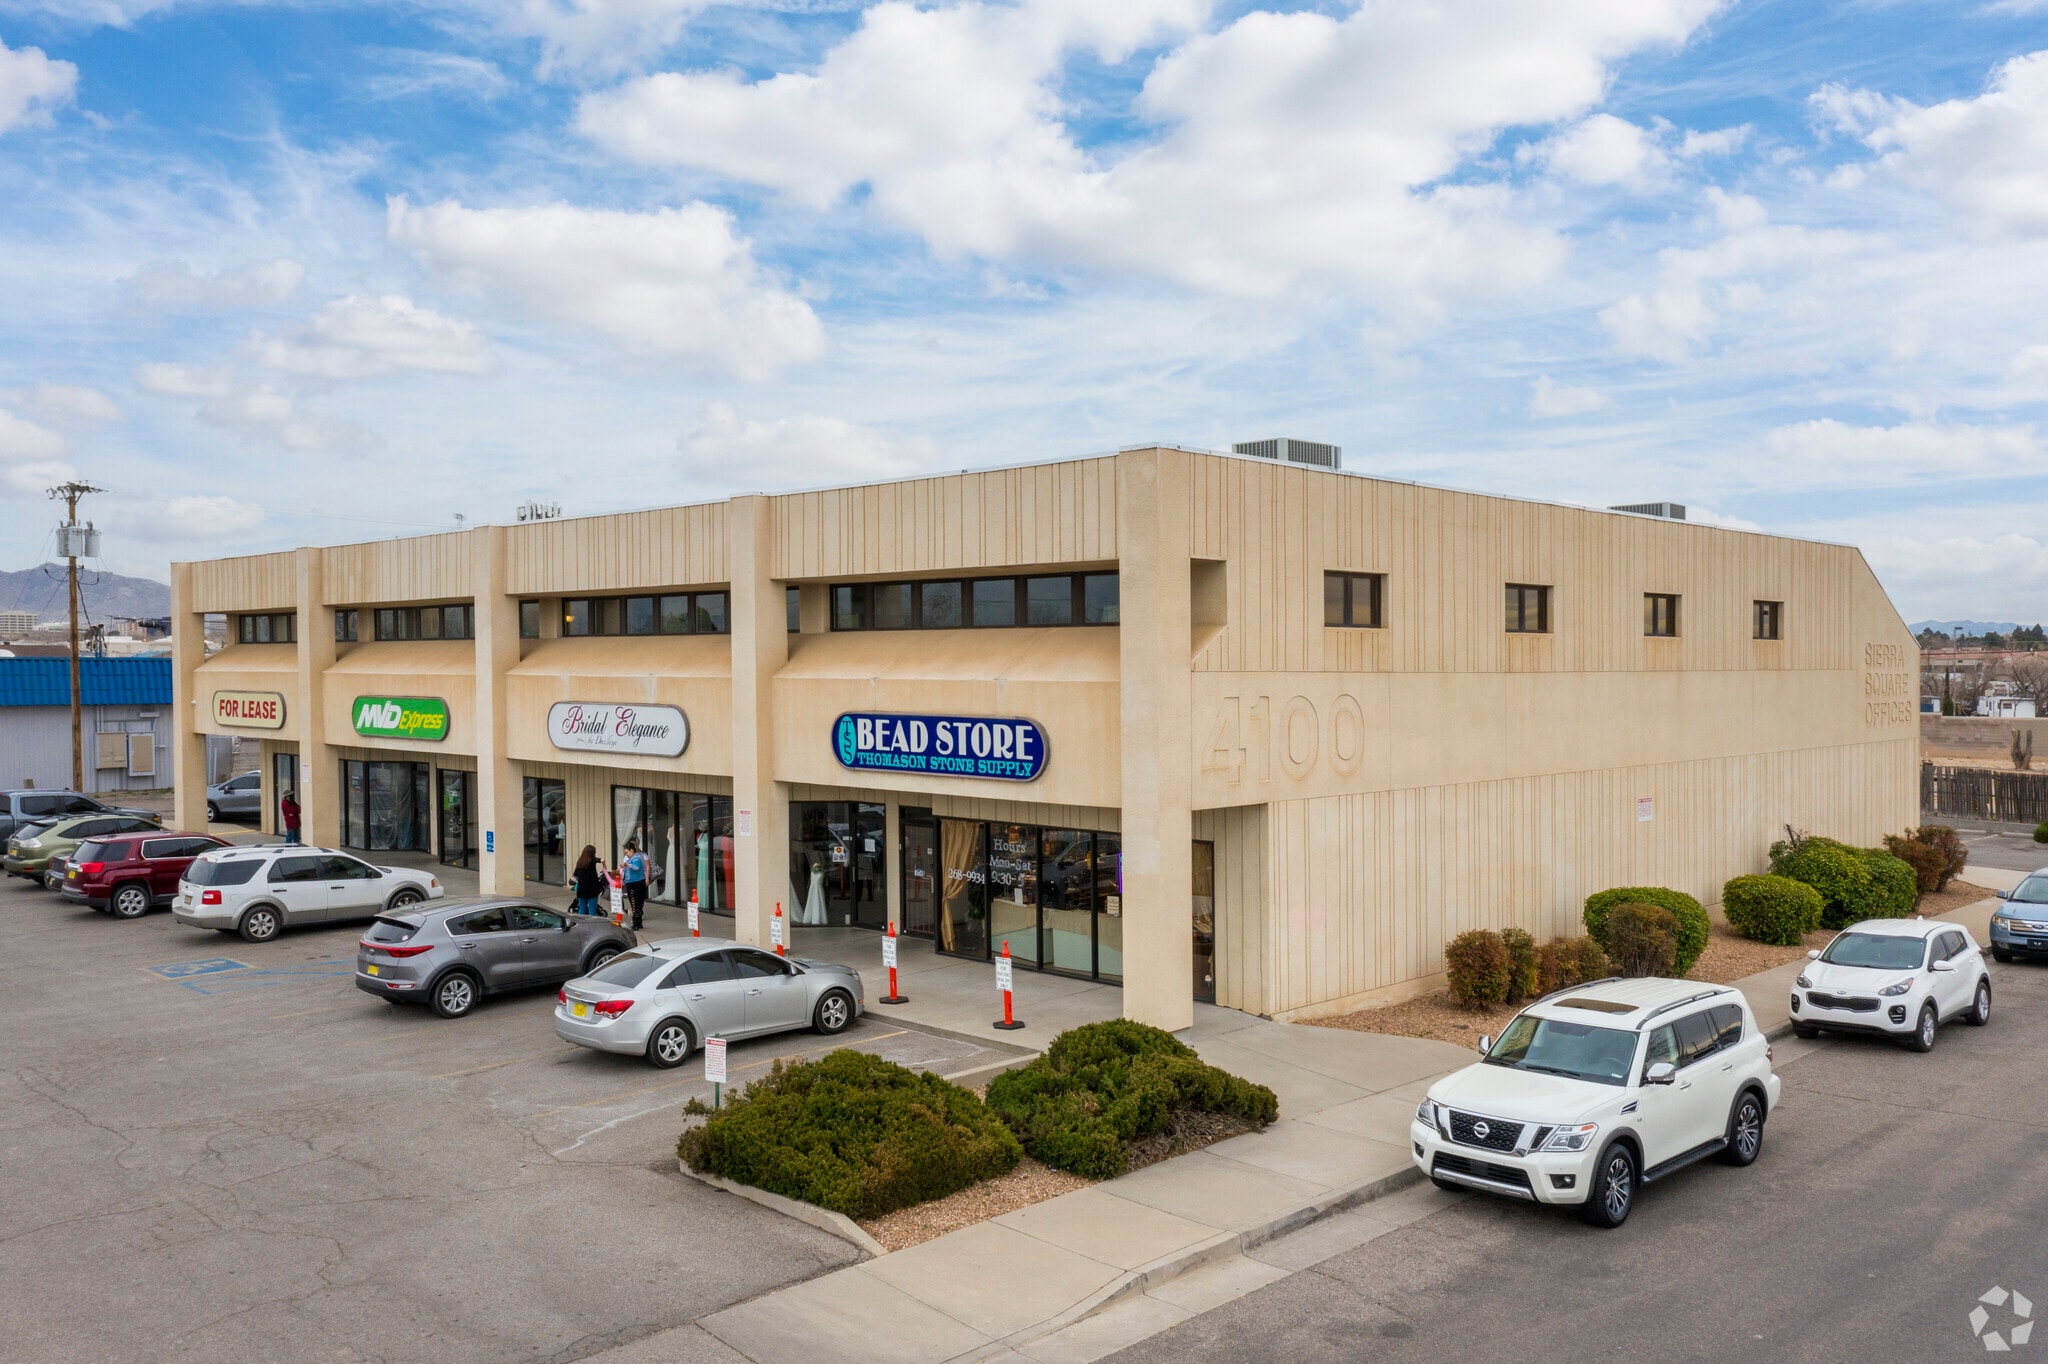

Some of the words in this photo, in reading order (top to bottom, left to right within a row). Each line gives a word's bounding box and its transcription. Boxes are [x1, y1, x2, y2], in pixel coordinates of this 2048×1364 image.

[1864, 642, 1905, 668] SIERRA
[1864, 672, 1909, 696] SQUARE
[219, 699, 239, 717] FOR
[241, 700, 277, 720] LEASE
[356, 700, 402, 729] MVD
[398, 710, 445, 734] Express
[1865, 701, 1912, 727] OFFICES
[561, 705, 608, 735] Bridal
[615, 706, 670, 748] Elegance
[857, 718, 929, 753] BEAD
[935, 721, 1034, 760] STORE
[1201, 693, 1365, 785] 4100
[857, 752, 927, 769] THOMASON
[930, 756, 974, 773] STONE
[978, 761, 1034, 777] SUPPLY
[993, 838, 1026, 853] Hours
[989, 855, 1032, 871] Mon-Sat
[948, 868, 985, 885] 268-9934
